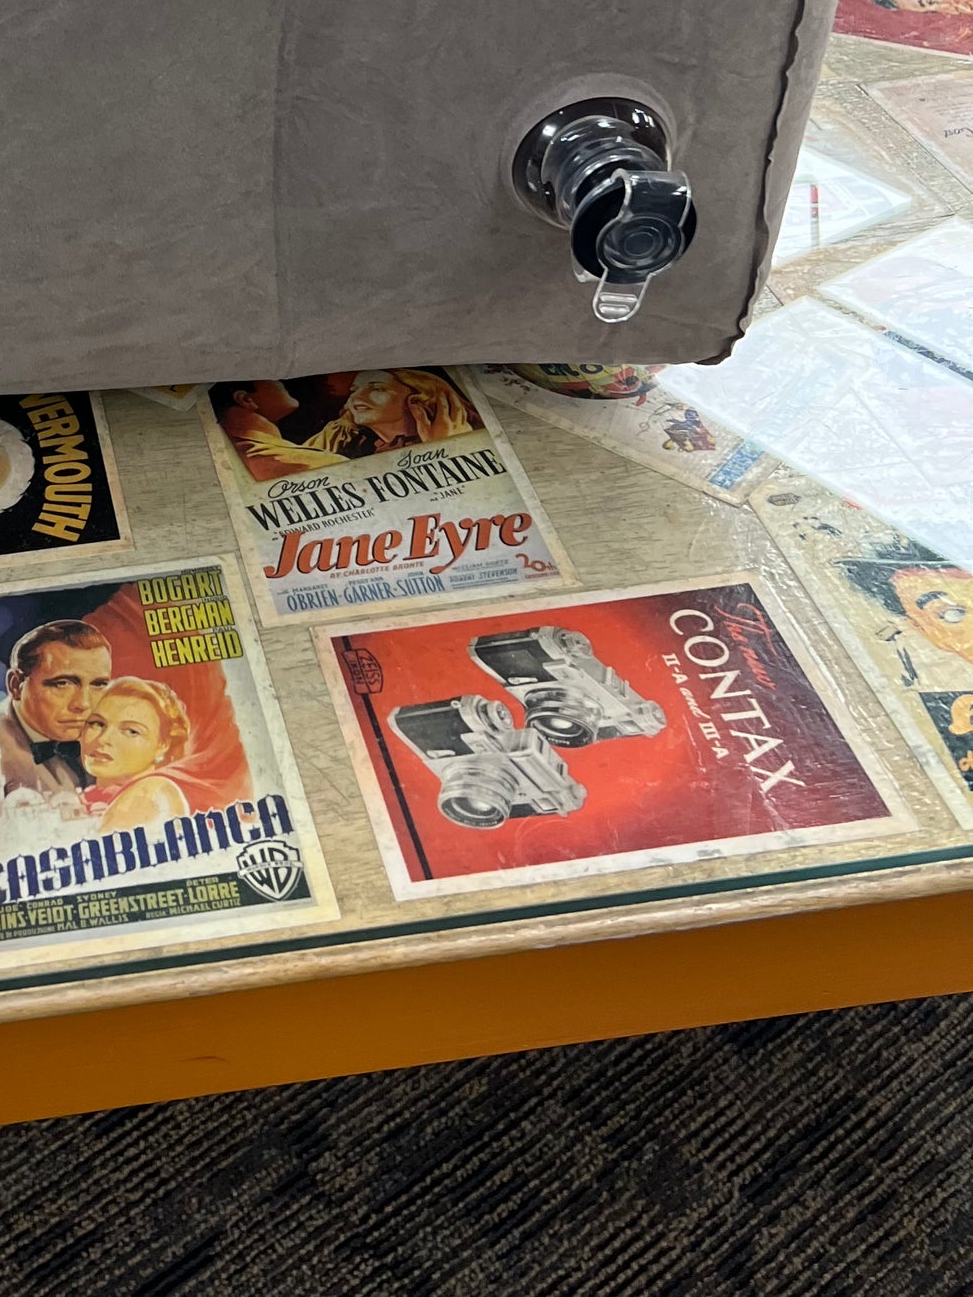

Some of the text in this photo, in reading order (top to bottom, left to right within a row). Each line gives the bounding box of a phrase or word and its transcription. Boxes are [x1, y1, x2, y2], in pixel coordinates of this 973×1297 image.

[19, 394, 92, 542] VERMOUTH
[397, 448, 449, 469] Joan
[245, 449, 507, 531] WELLES FONTAINE
[268, 476, 330, 499] Orson
[321, 507, 376, 528] ROCHESTER"
[263, 513, 532, 579] Jane Eyre
[342, 565, 390, 578] CHARLOTTE
[392, 560, 425, 571] BRONTE
[478, 567, 518, 580] STEVENSON
[515, 553, 558, 572] 20th
[137, 569, 224, 606] BOGART
[343, 580, 395, 604] GARNER
[397, 575, 446, 597] SUTTON
[144, 599, 235, 636] BERGMAN
[151, 630, 244, 669] HENREID
[359, 655, 382, 686] ZEISS
[662, 653, 730, 760] II-A and III-A
[669, 608, 807, 794] CONTAX
[26, 898, 64, 910] CONRAD
[76, 891, 117, 902] SYDNEY
[186, 877, 219, 886] PETER
[27, 905, 73, 925] VEIDT
[78, 889, 184, 919] GREENSTREET
[187, 881, 240, 904] LORRE
[169, 904, 211, 917] MICHAEL
[211, 897, 242, 910] CURTIZ
[57, 921, 78, 932] HAL
[88, 914, 130, 927] WALLIS
